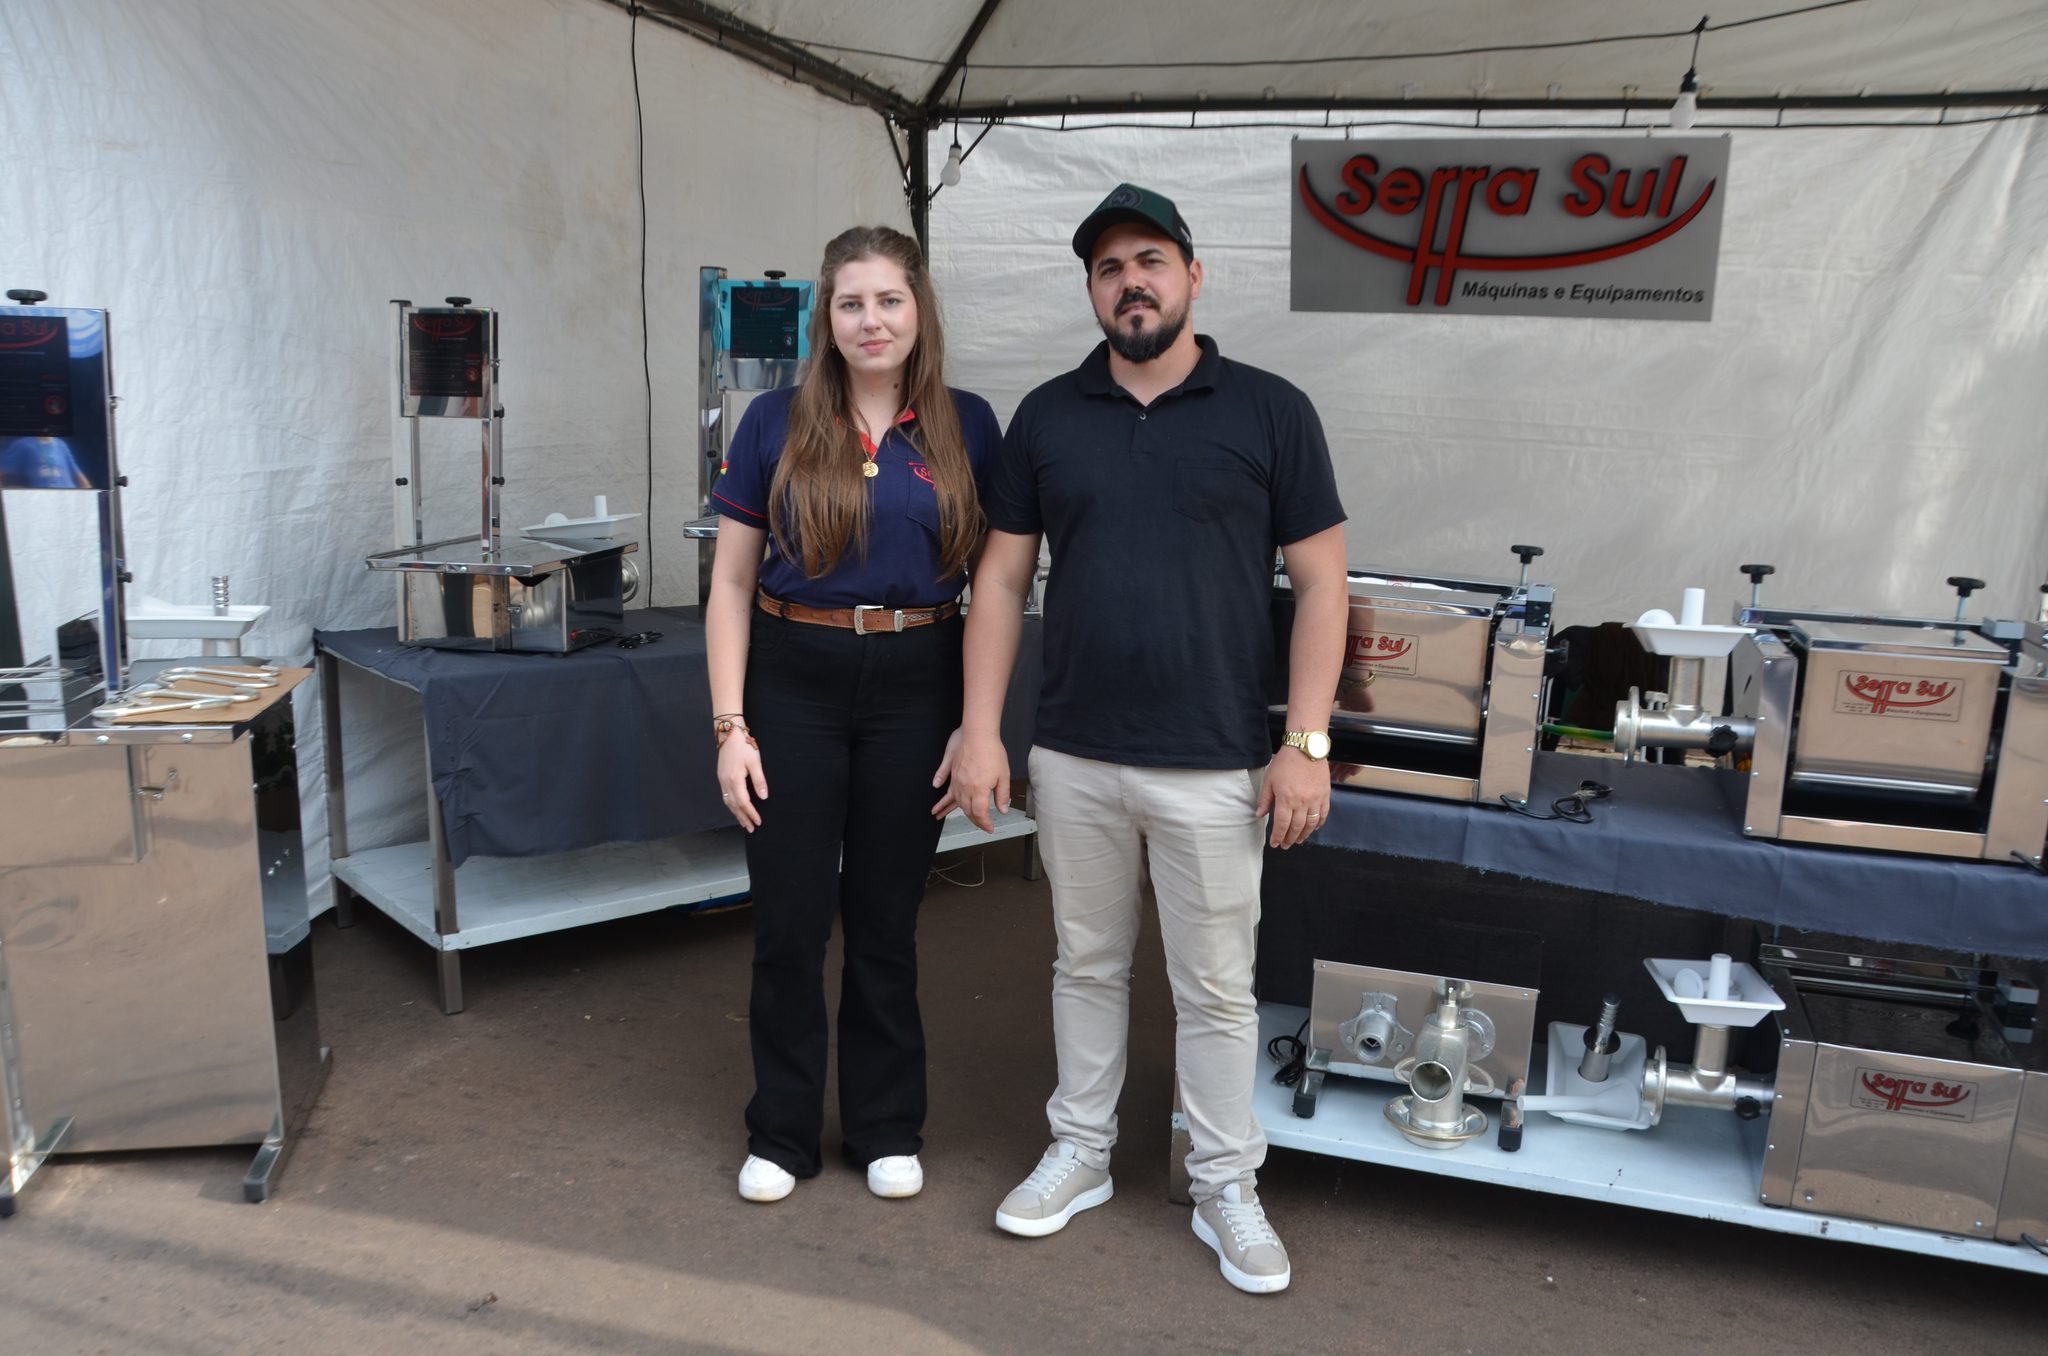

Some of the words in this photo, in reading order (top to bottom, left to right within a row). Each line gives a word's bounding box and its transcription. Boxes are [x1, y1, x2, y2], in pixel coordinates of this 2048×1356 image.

[1336, 154, 1540, 306] Serra
[1563, 153, 1689, 218] Sul
[1462, 280, 1550, 300] Máquinas
[1554, 287, 1566, 299] e
[1570, 283, 1706, 304] Equipamentos
[1377, 635, 1405, 652] Sul
[1854, 675, 1912, 714] Serra
[1915, 680, 1949, 697] Sul
[1871, 1073, 1928, 1111] Serra
[1930, 1081, 1963, 1099] Sul
